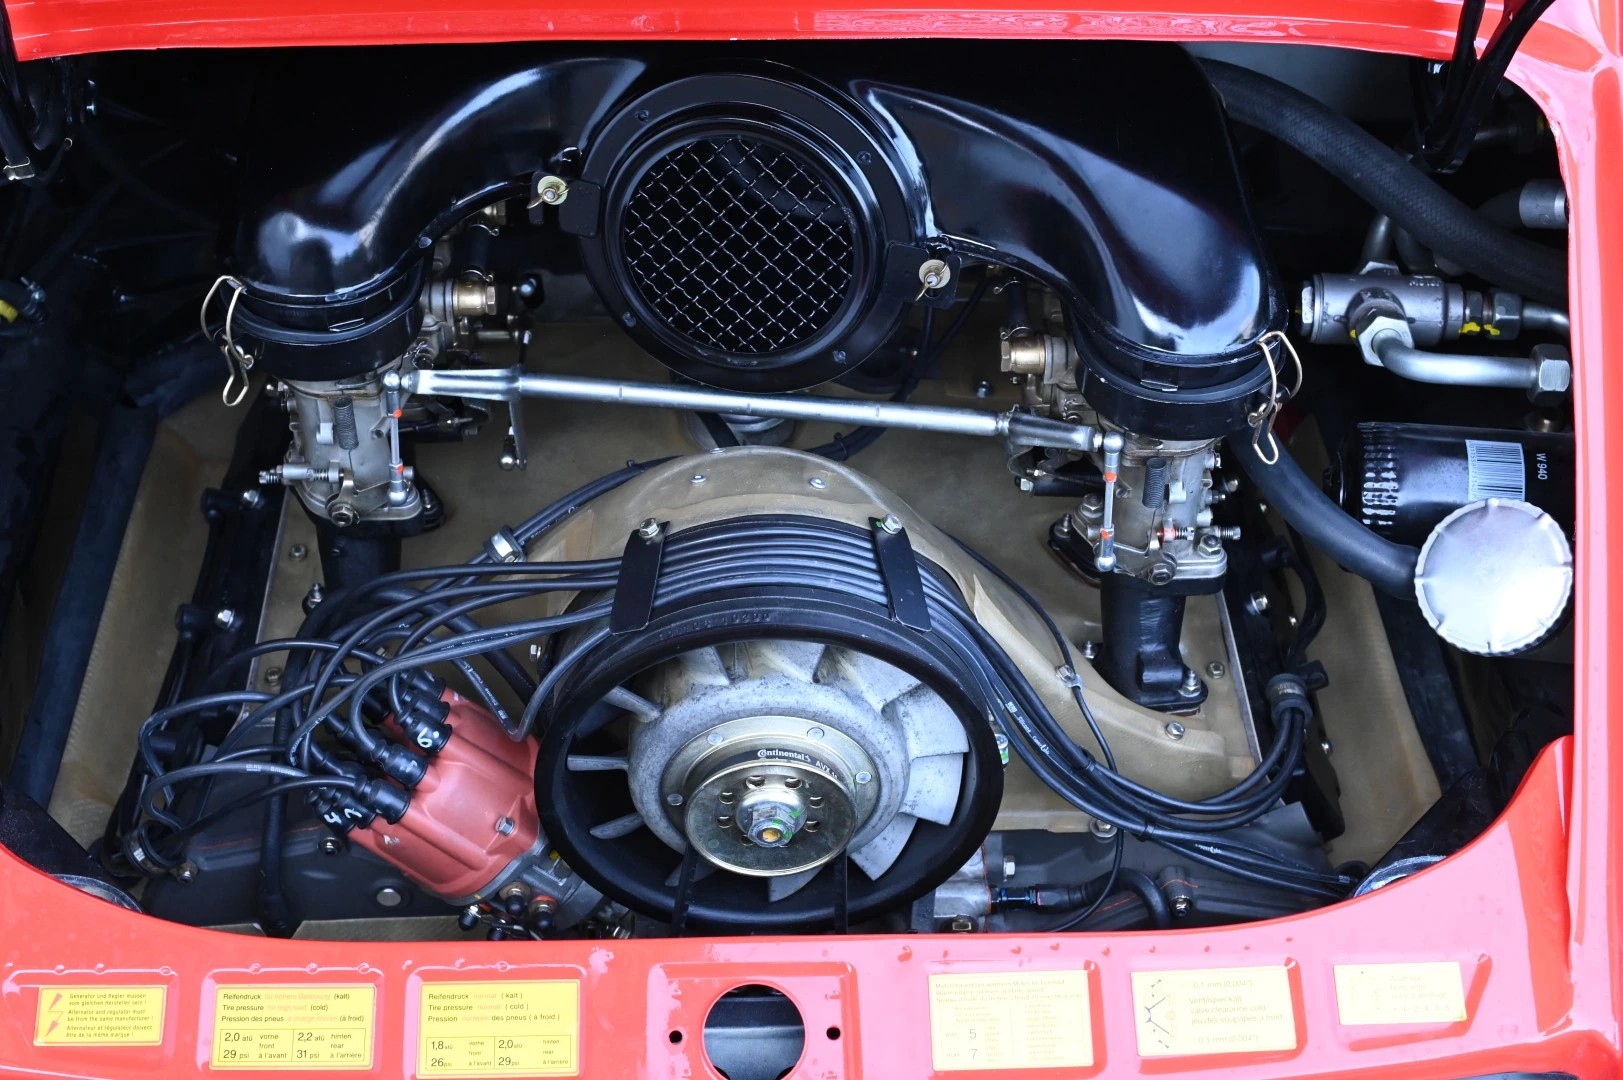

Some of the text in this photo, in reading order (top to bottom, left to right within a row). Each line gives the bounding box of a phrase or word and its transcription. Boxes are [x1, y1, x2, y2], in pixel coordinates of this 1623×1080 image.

[1537, 463, 1548, 480] 940
[224, 1032, 240, 1043] 2,0
[297, 1032, 313, 1042] 2,2
[969, 1028, 977, 1039] 5
[431, 1041, 444, 1051] 1,8
[498, 1039, 514, 1050] 2,0
[223, 1050, 237, 1059] 29
[239, 1052, 250, 1060] psi
[296, 1049, 307, 1059] 31
[309, 1052, 320, 1060] psi
[970, 1048, 978, 1059] 7
[430, 1058, 444, 1067] 26
[498, 1056, 511, 1066] 29
